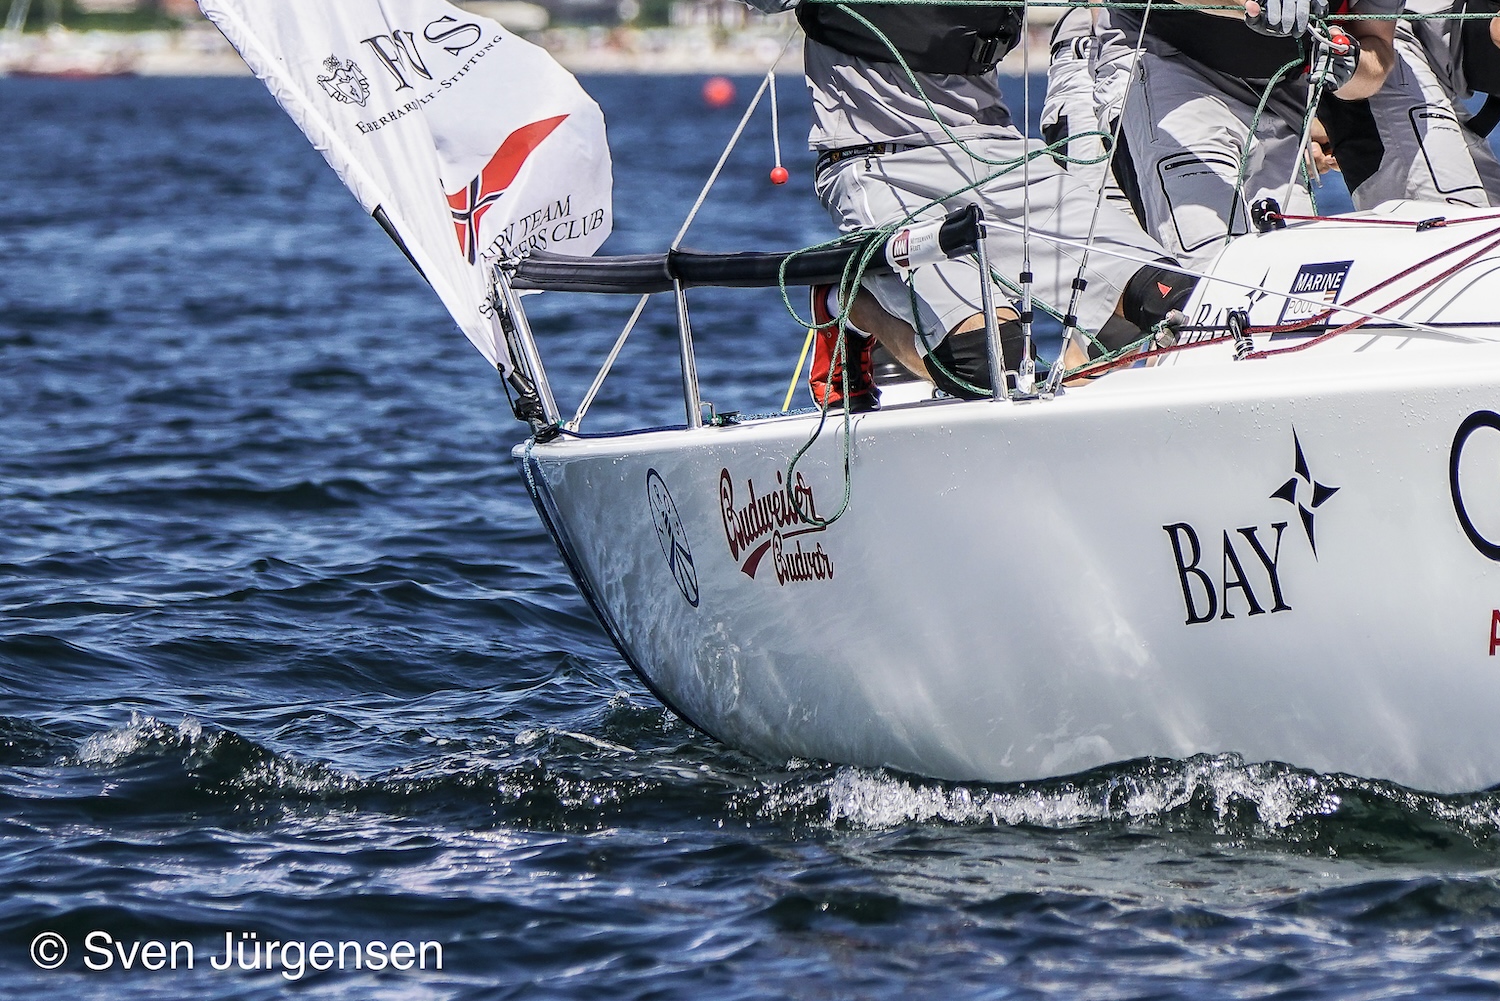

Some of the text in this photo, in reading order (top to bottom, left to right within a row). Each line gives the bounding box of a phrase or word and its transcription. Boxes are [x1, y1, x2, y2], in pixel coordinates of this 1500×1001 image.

[519, 194, 571, 239] TEAM
[551, 208, 605, 243] CLUB
[1293, 271, 1346, 292] MARINE
[1286, 299, 1313, 315] POOL
[1162, 521, 1293, 626] BAY
